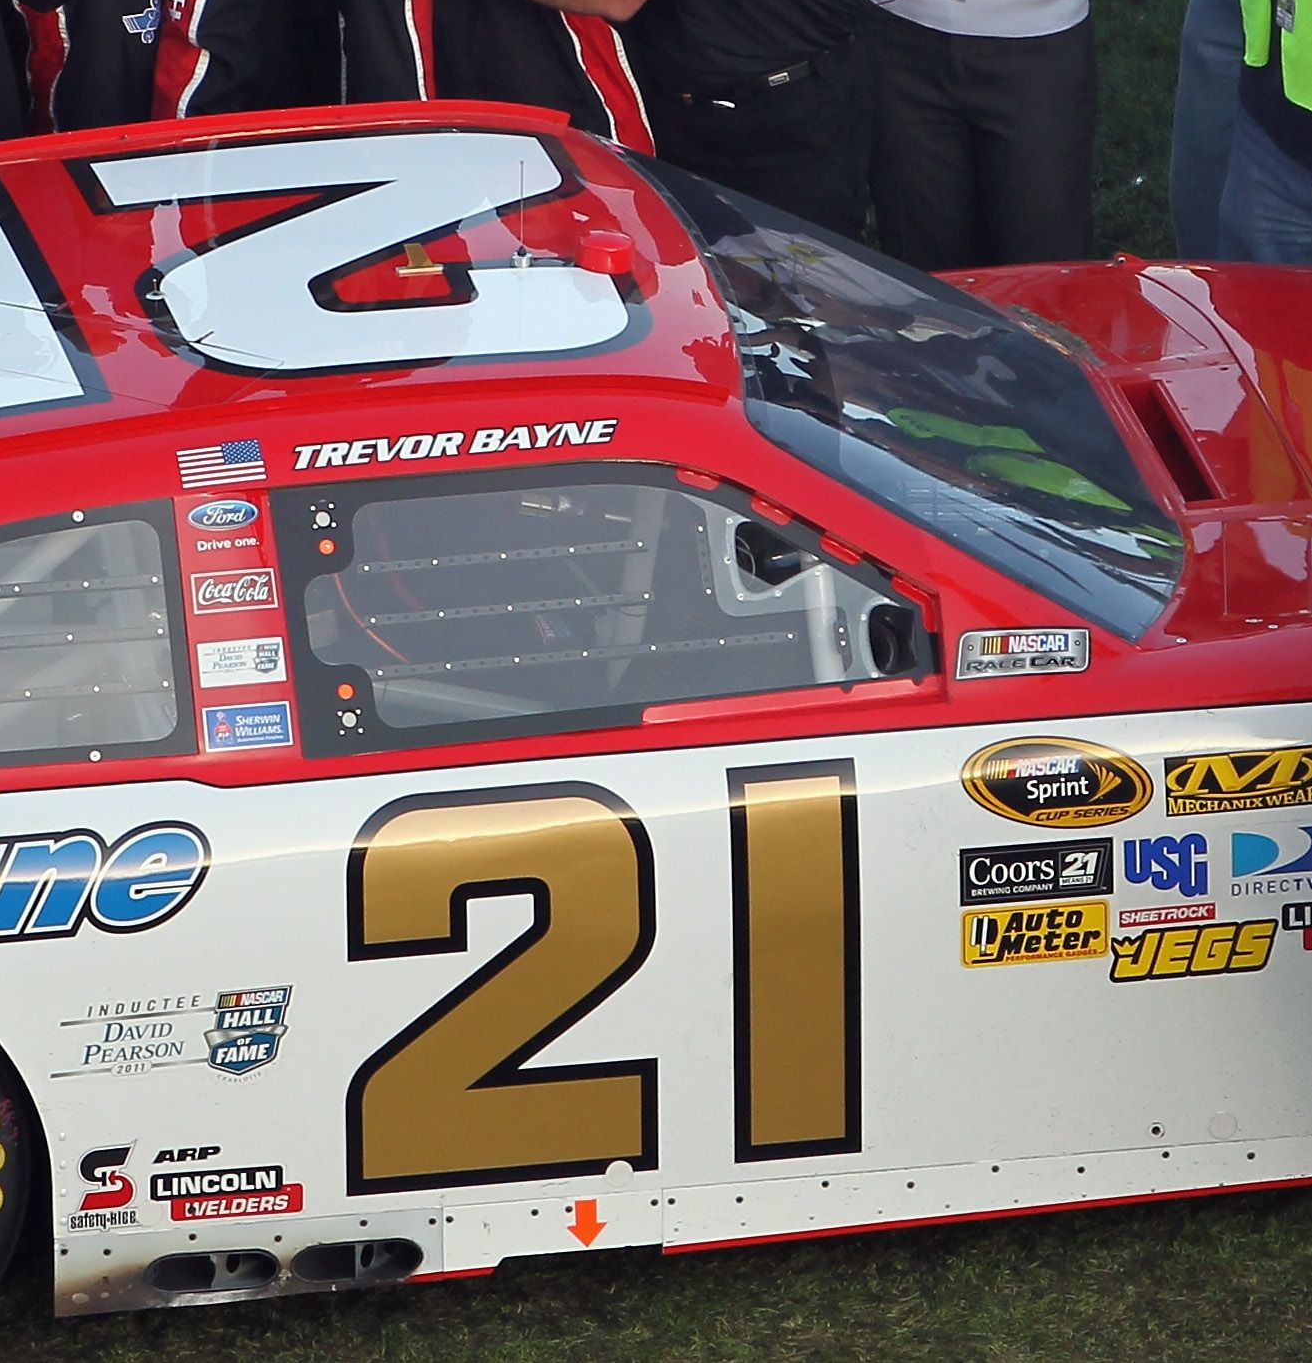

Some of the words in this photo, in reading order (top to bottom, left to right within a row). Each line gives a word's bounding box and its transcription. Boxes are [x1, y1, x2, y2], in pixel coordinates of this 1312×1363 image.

[293, 435, 466, 472] TREVOR
[468, 419, 619, 456] BAYNE
[201, 503, 247, 526] Ford
[196, 539, 232, 552] Drive
[234, 536, 260, 548] one.
[1007, 634, 1066, 654] NASCAR
[966, 658, 1028, 673] RACE
[1029, 656, 1077, 669] CAR
[1015, 754, 1080, 778] NASCAR
[1026, 775, 1089, 804] Sprint
[1034, 808, 1070, 823] CUP
[1071, 805, 1131, 819] SERIES
[1167, 795, 1265, 816] MECHANIX
[968, 856, 1056, 886] Coors
[1061, 850, 1100, 877] 21
[1123, 832, 1210, 898] USG
[971, 885, 1011, 898] BREWING
[1012, 882, 1054, 895] COMPANY
[1002, 907, 1085, 934] Auto
[1120, 906, 1211, 924] SHEETROCK
[999, 927, 1102, 958] Meter
[1116, 921, 1277, 982] JEGS
[346, 756, 862, 1197] 21
[87, 994, 202, 1019] INDUCTEE
[239, 989, 286, 1006] NASCAR
[222, 1007, 277, 1030] HALL
[103, 1022, 174, 1043] DAVID
[236, 1036, 253, 1046] OF
[82, 1040, 186, 1066] PEARSON
[214, 1042, 270, 1065] FAME
[115, 1063, 147, 1076] 2011
[152, 1145, 222, 1165] ARP
[156, 1170, 278, 1198] LINCOLN
[184, 1193, 290, 1220] WELDERS
